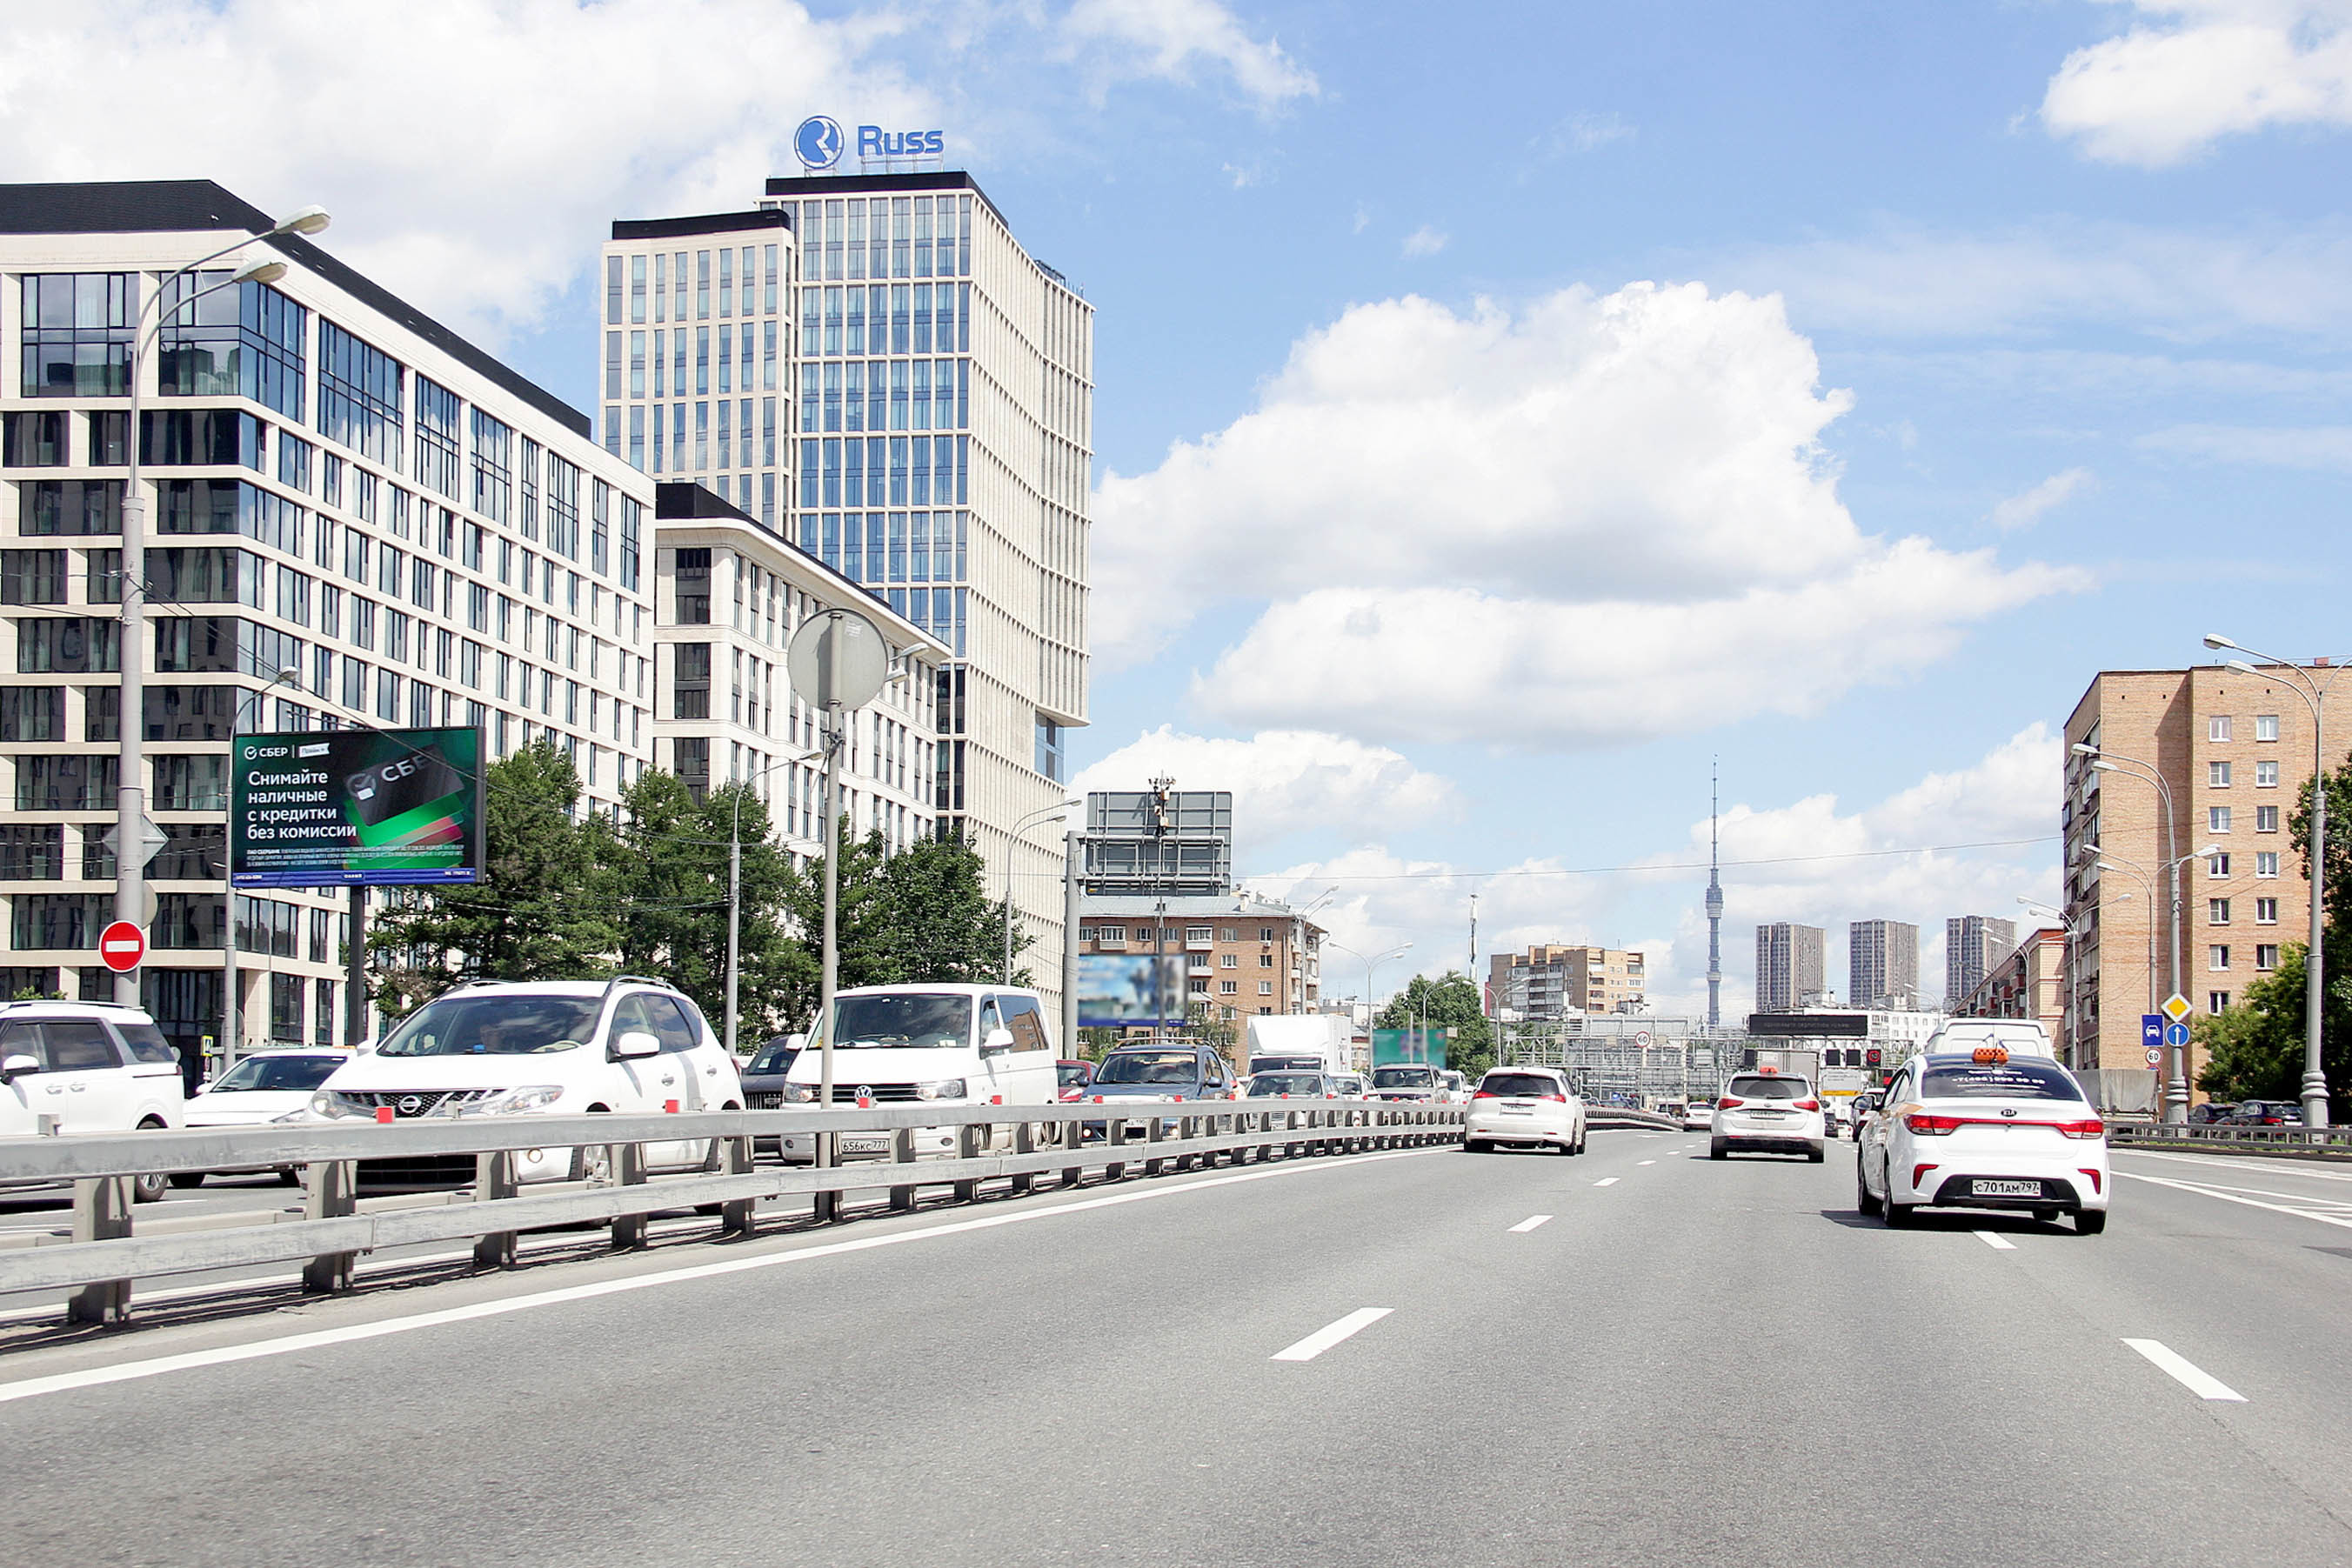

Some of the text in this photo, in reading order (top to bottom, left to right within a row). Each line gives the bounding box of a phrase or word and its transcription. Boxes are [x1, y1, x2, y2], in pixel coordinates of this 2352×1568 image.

[858, 125, 944, 157] Russ
[259, 747, 288, 757] СБЕР
[248, 768, 328, 785] Снимайте
[248, 791, 328, 804] наличные
[248, 808, 337, 824] с кредитки
[247, 824, 357, 839] без комиссии
[843, 1142, 872, 1151] 656КС
